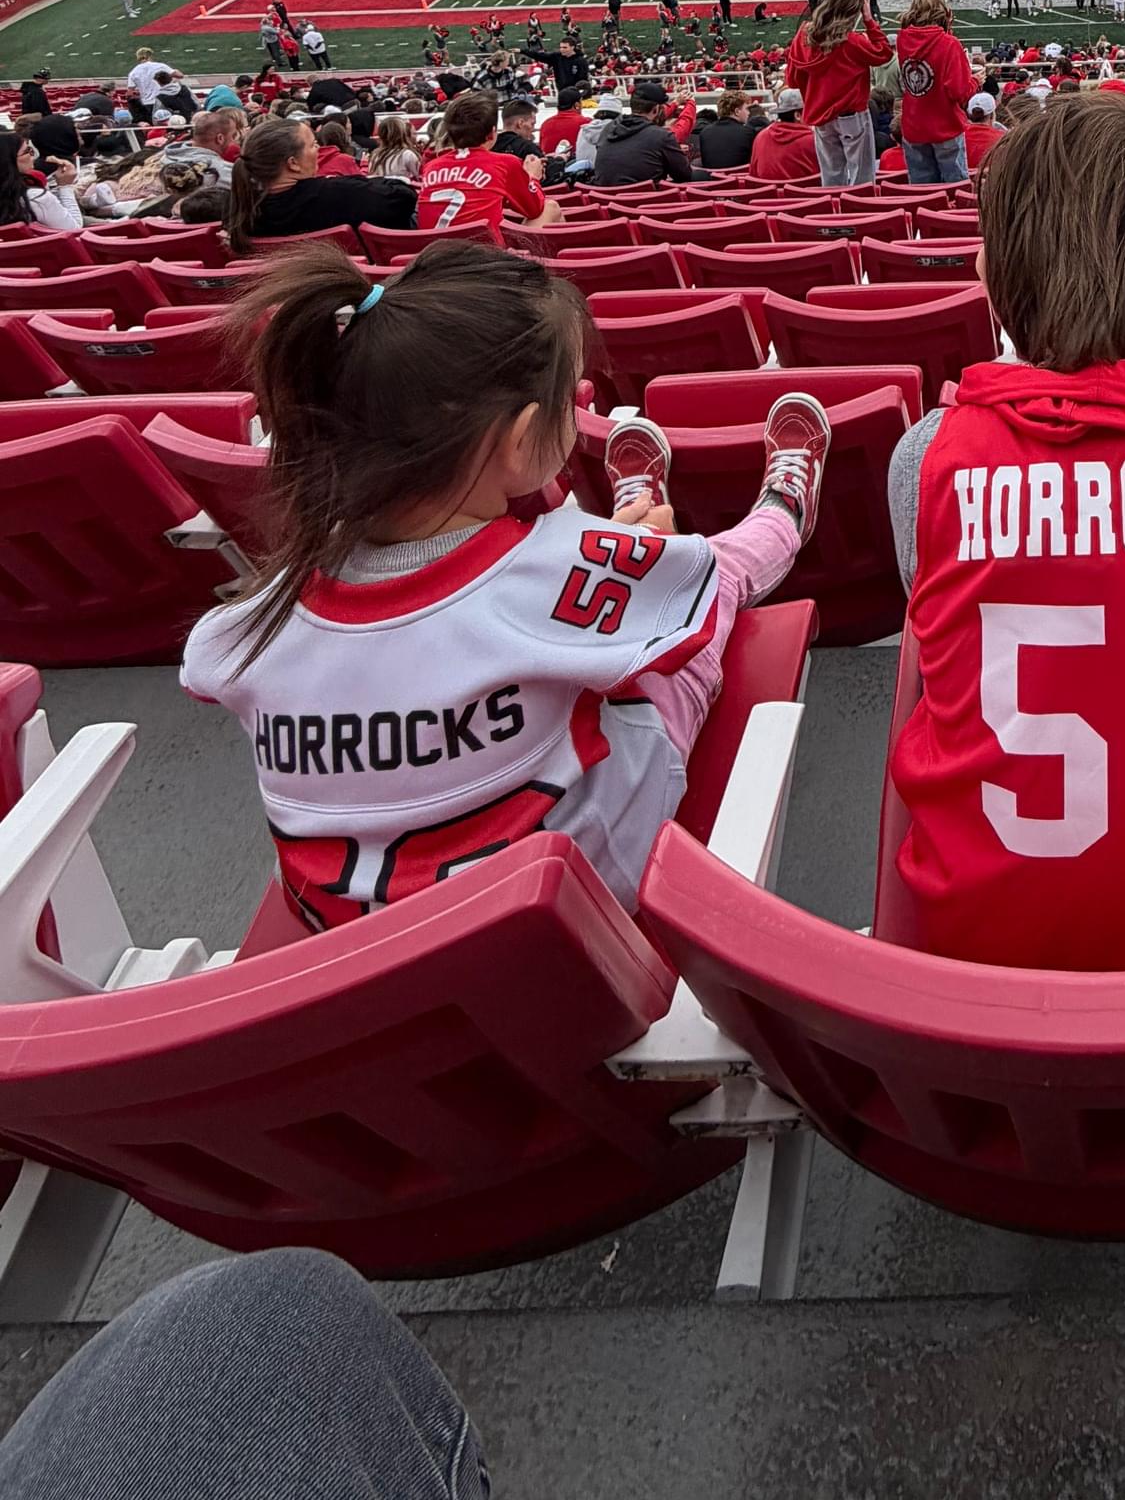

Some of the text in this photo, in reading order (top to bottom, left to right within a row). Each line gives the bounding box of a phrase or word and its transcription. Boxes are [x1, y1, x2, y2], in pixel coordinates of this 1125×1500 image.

[430, 188, 466, 228] 7
[550, 529, 666, 635] 52
[255, 684, 525, 775] HORROCKS
